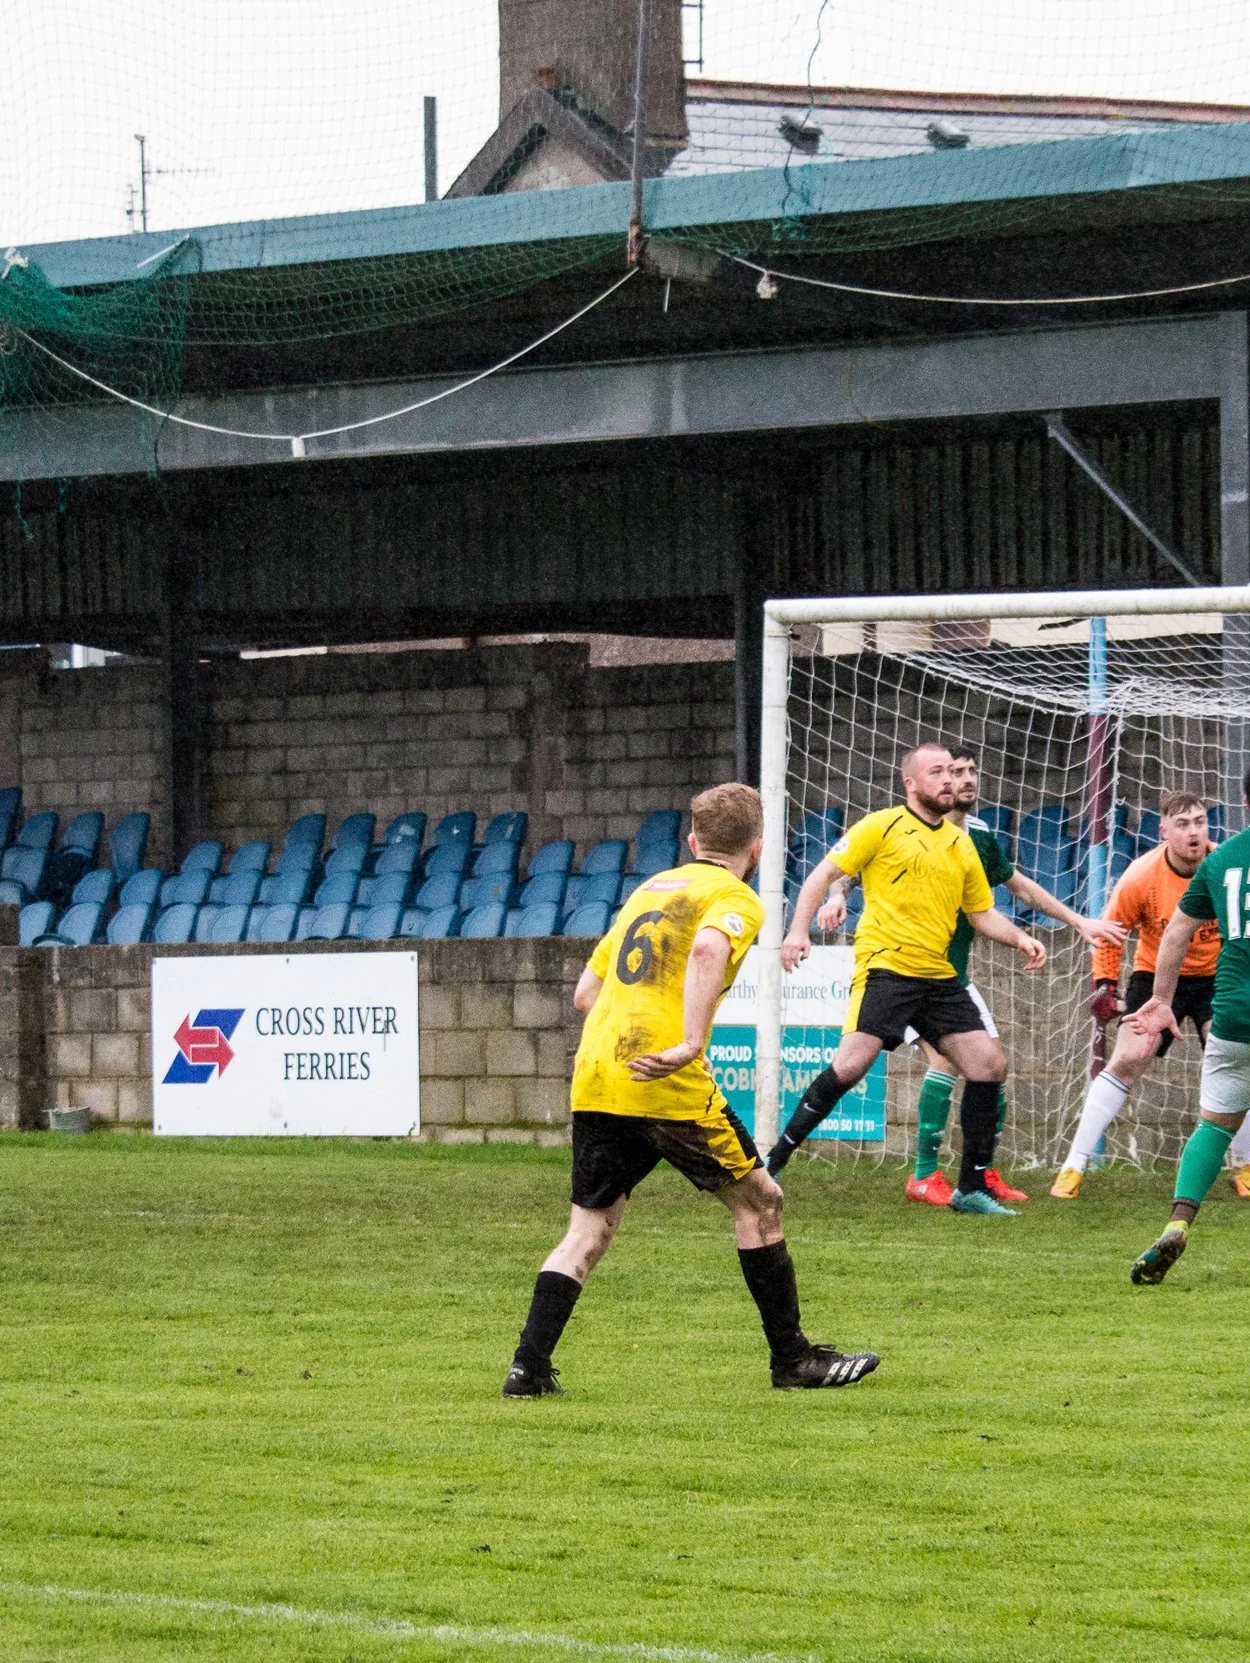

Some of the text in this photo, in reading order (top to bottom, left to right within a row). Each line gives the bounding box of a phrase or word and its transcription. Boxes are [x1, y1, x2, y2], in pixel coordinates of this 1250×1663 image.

[616, 910, 664, 985] 6
[781, 984, 828, 1000] urance
[256, 1006, 399, 1036] CROSS RIVER
[284, 1051, 371, 1080] FERRIES
[710, 1045, 752, 1062] PROUD
[754, 1046, 821, 1063] NSORS
